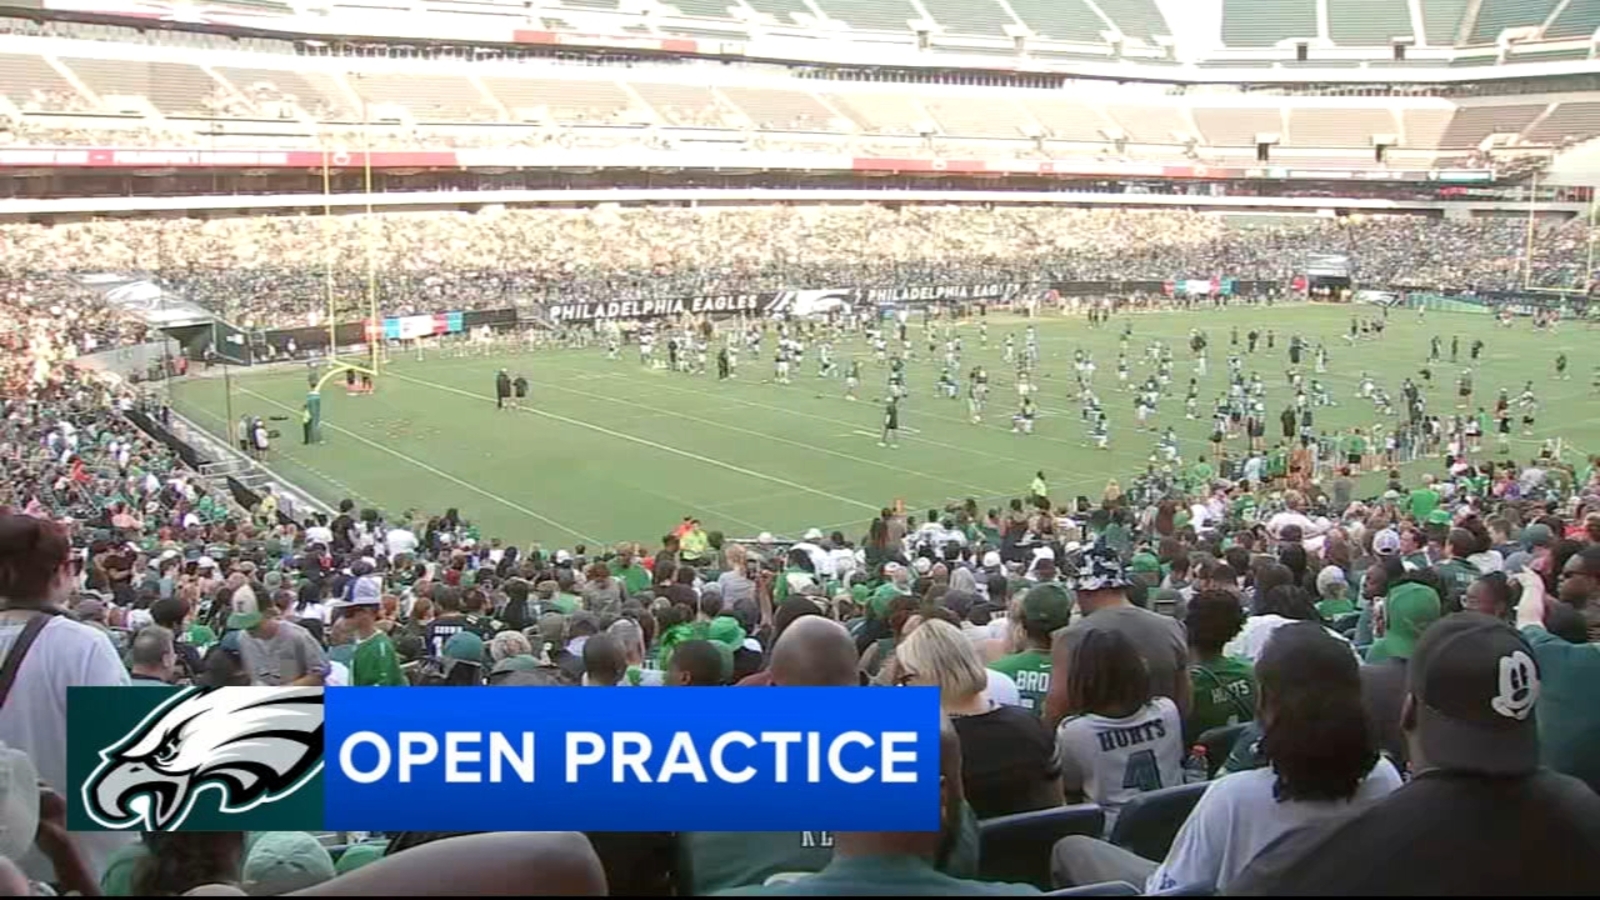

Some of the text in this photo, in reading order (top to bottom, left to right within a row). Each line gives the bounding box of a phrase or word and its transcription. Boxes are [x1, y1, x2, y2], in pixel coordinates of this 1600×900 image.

[868, 285, 967, 301] PHILADELPHIA
[551, 295, 757, 320] PHILADELPHIA EAGLES
[1097, 718, 1166, 752] HURTS
